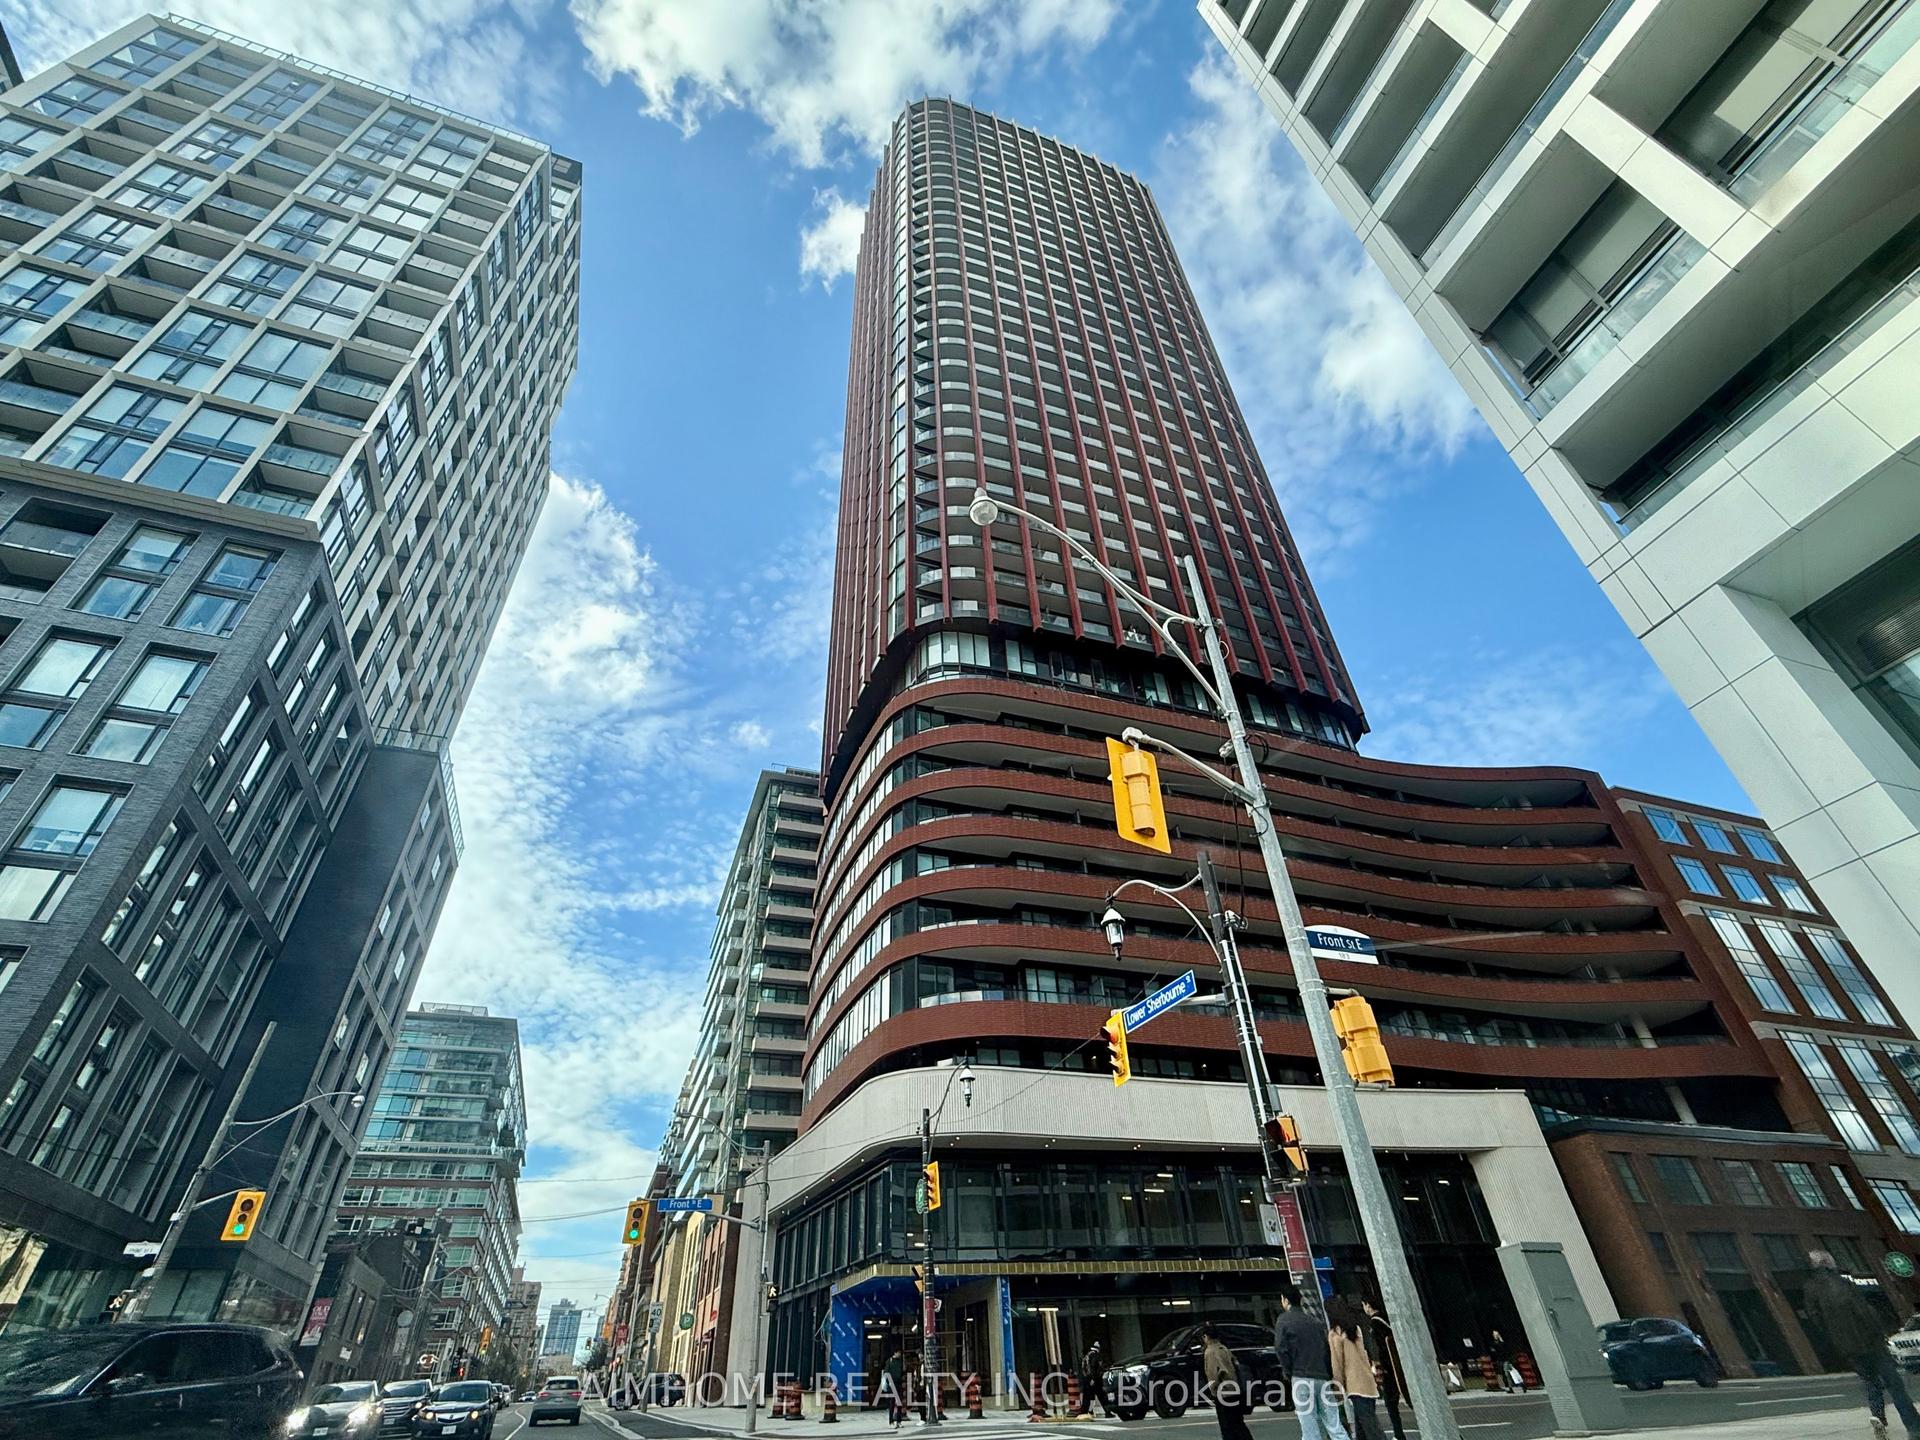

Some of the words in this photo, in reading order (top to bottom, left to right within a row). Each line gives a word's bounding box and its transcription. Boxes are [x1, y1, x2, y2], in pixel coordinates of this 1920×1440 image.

[1317, 933, 1346, 949] Front
[1355, 939, 1363, 950] E
[1126, 1005, 1146, 1026] Lower
[1146, 982, 1186, 1014] Sherbourne
[669, 1200, 690, 1209] Front
[696, 1200, 702, 1208] E
